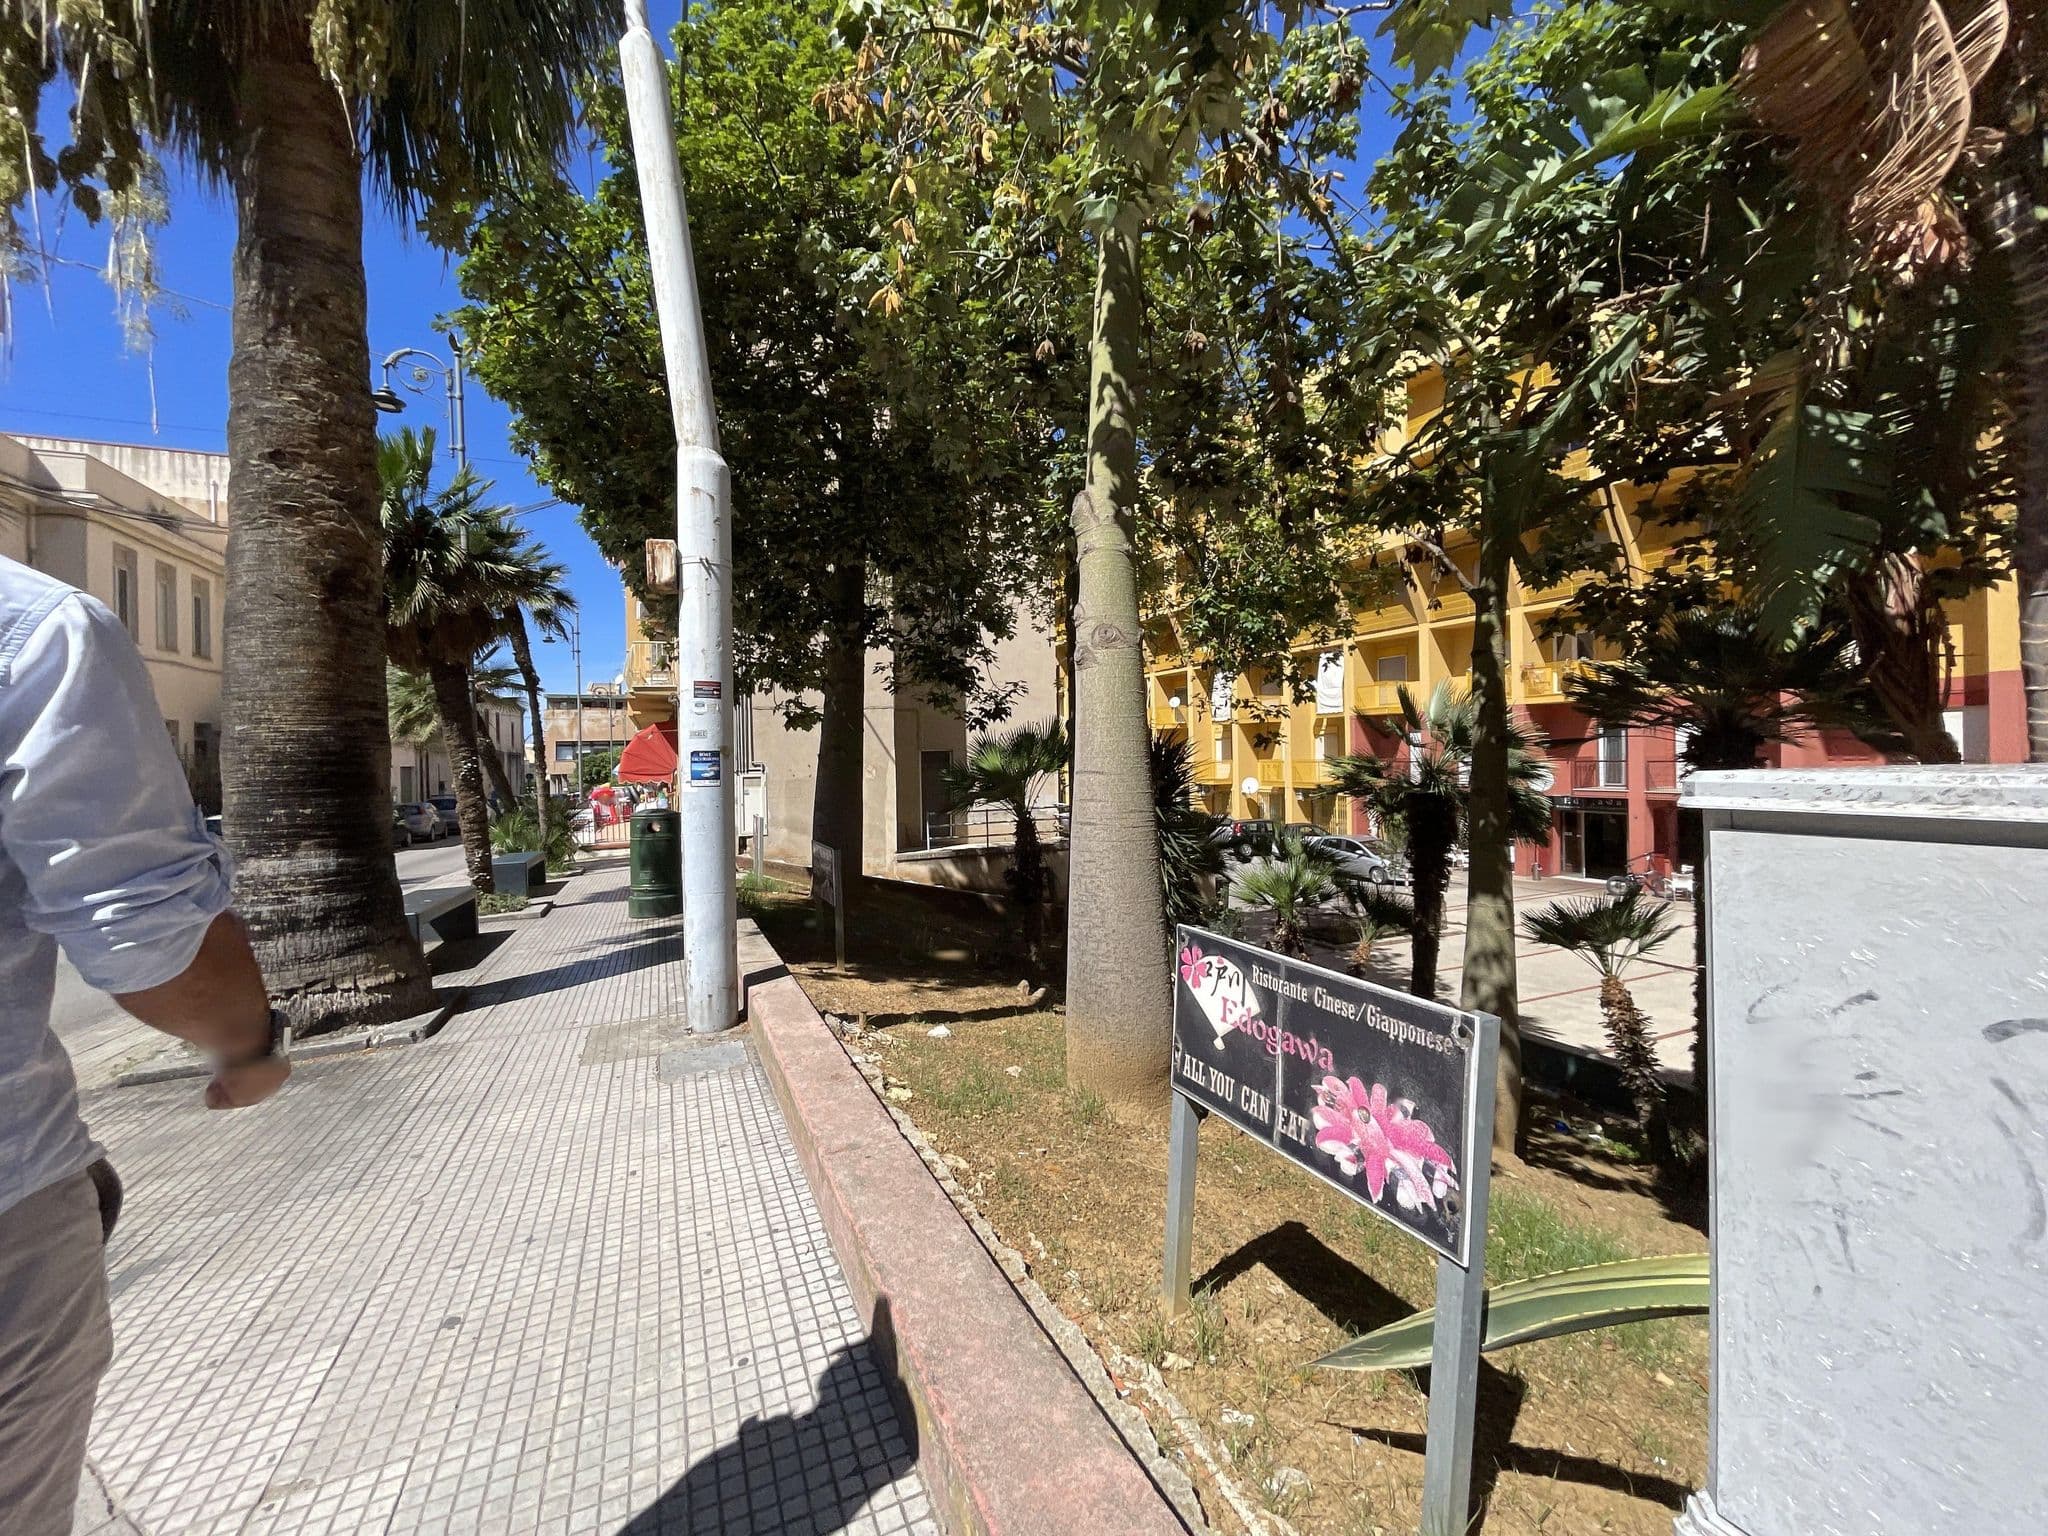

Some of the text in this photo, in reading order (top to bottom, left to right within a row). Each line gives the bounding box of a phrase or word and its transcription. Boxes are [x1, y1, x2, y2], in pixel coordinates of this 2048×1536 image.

[1220, 996, 1335, 1072] Edogawa
[1251, 964, 1453, 1056] Ristorante Cinese/Giapponese
[1182, 1054, 1311, 1146] ALL YOU CAN EAT
